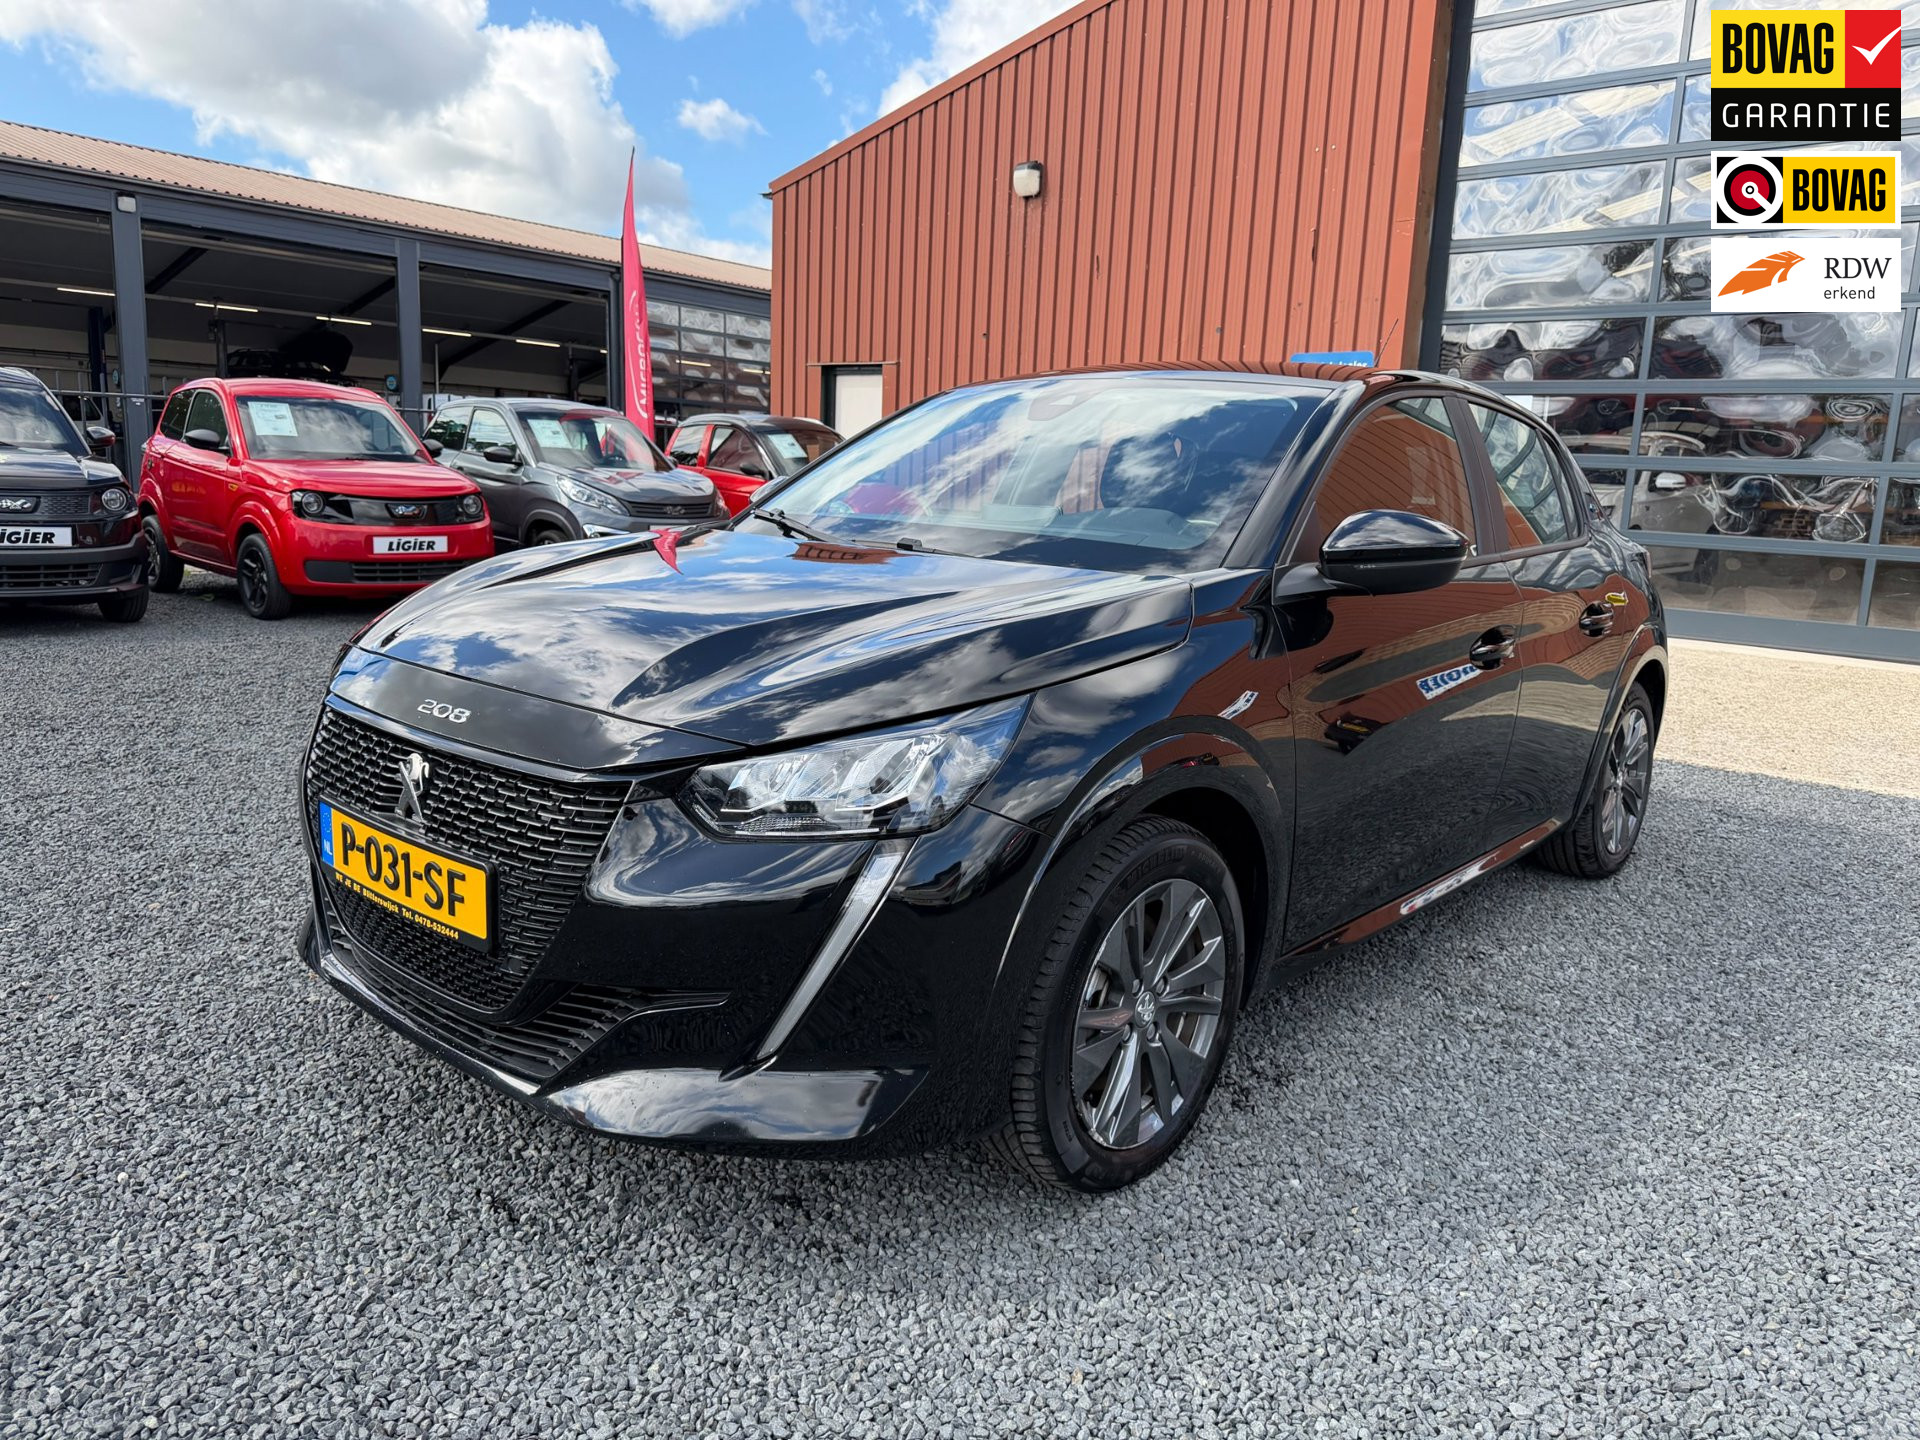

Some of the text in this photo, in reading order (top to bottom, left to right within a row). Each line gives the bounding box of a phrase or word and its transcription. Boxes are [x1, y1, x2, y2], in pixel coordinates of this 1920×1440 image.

[0, 529, 55, 544] IGIER
[417, 699, 471, 723] 208
[323, 838, 333, 856] NL
[341, 821, 466, 917] P-031-SF
